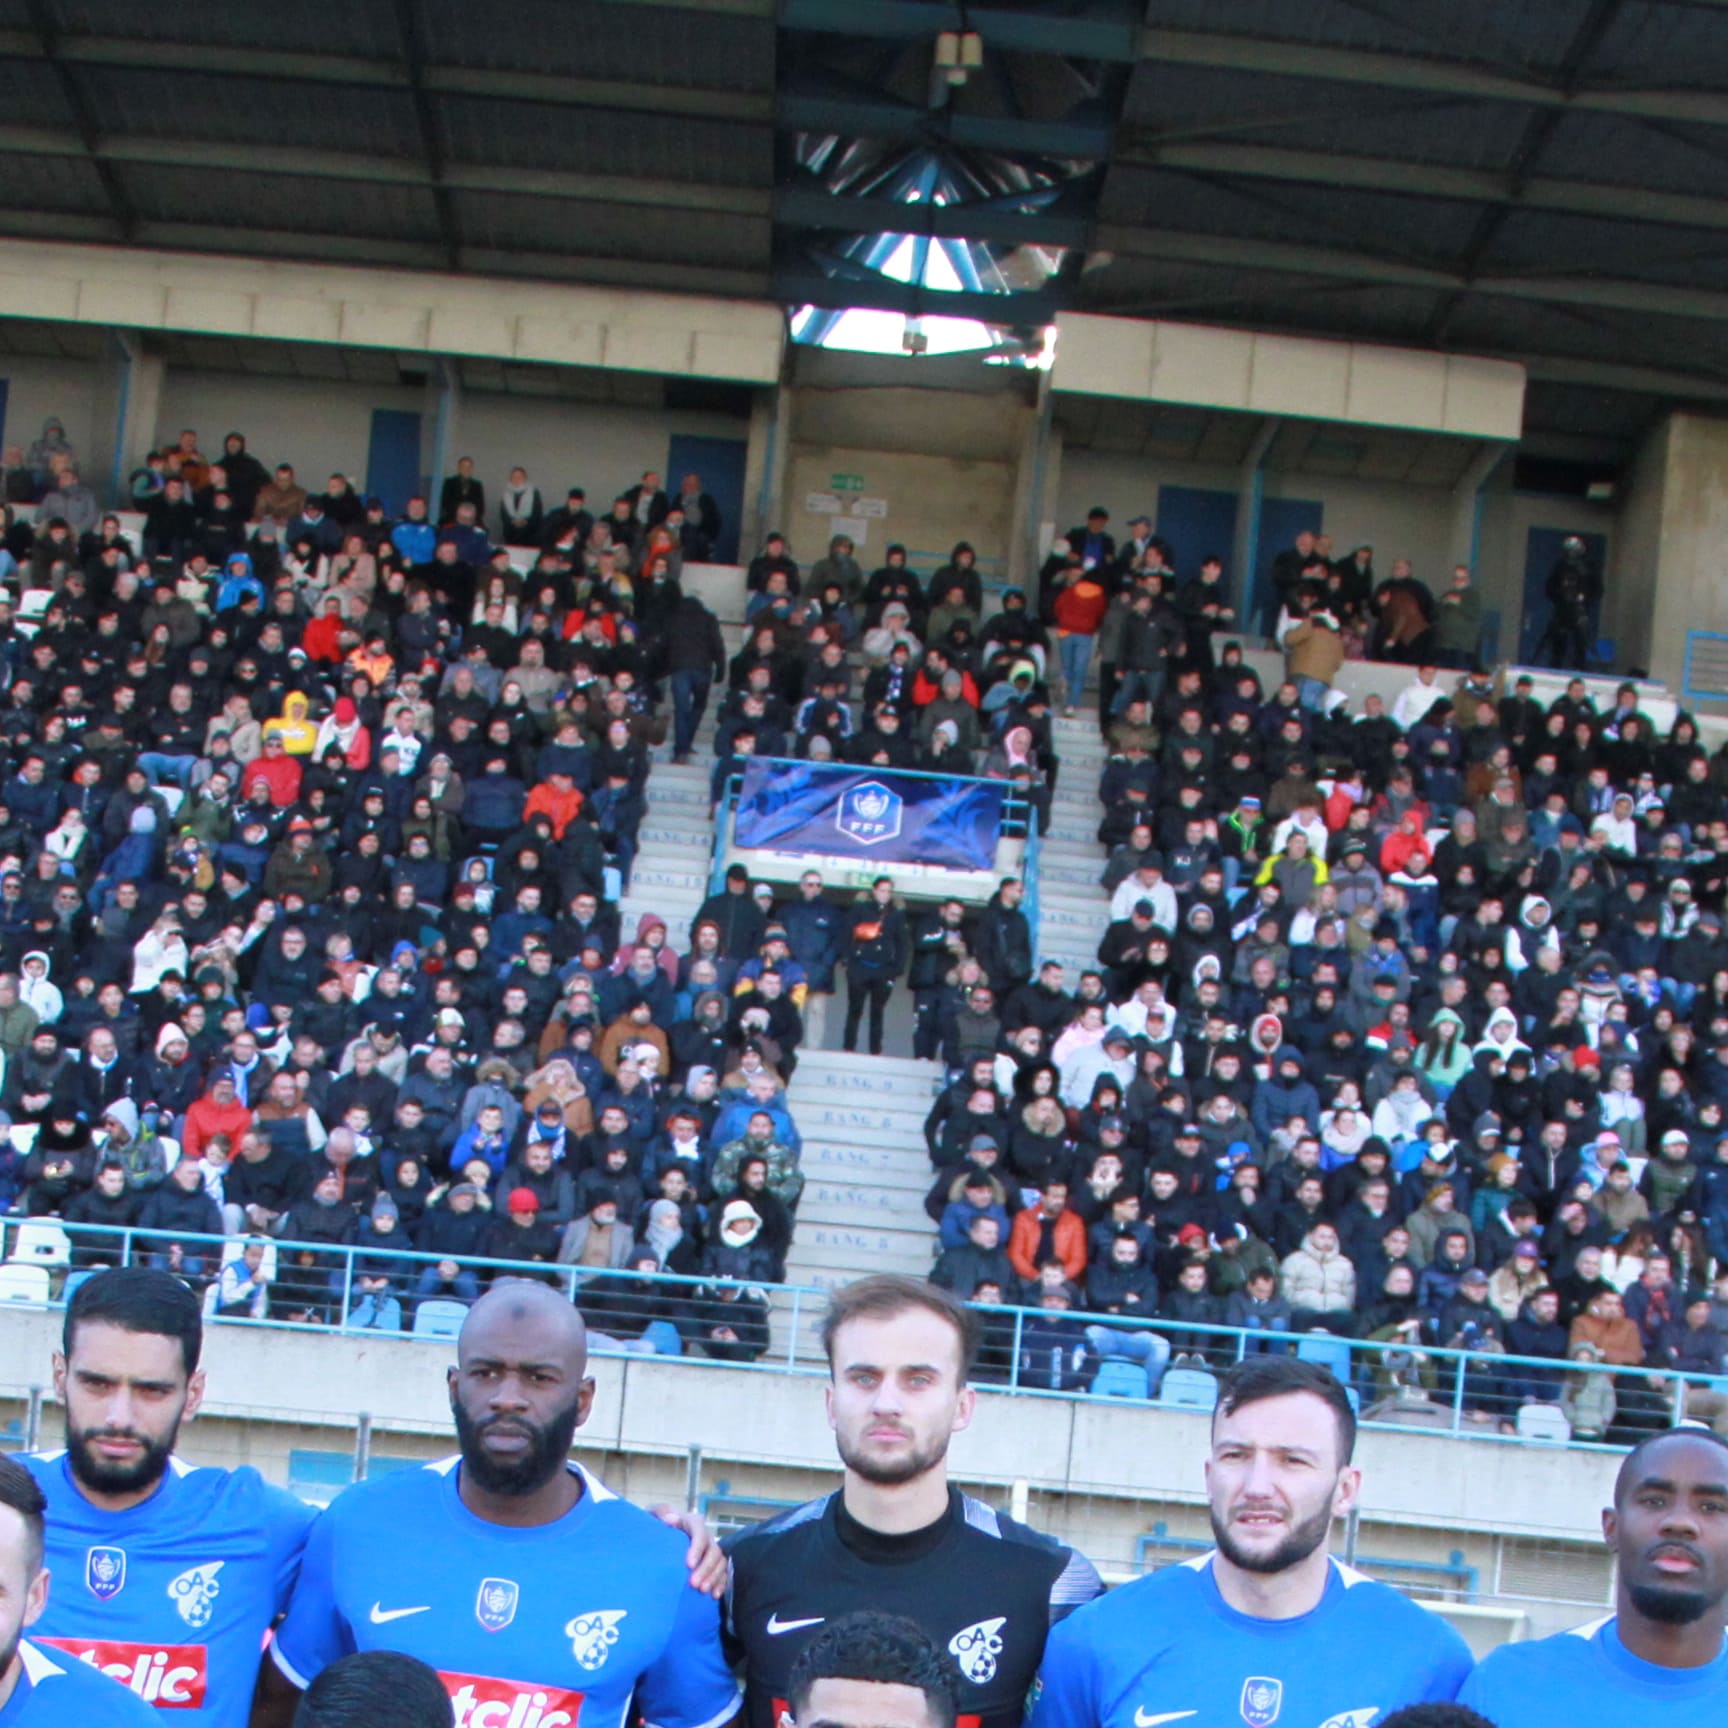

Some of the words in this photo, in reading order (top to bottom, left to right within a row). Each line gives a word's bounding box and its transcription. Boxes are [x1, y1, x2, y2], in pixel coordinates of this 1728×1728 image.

[175, 1571, 221, 1599] OAC
[574, 1614, 620, 1645] OAC
[956, 1626, 1004, 1656] OAC
